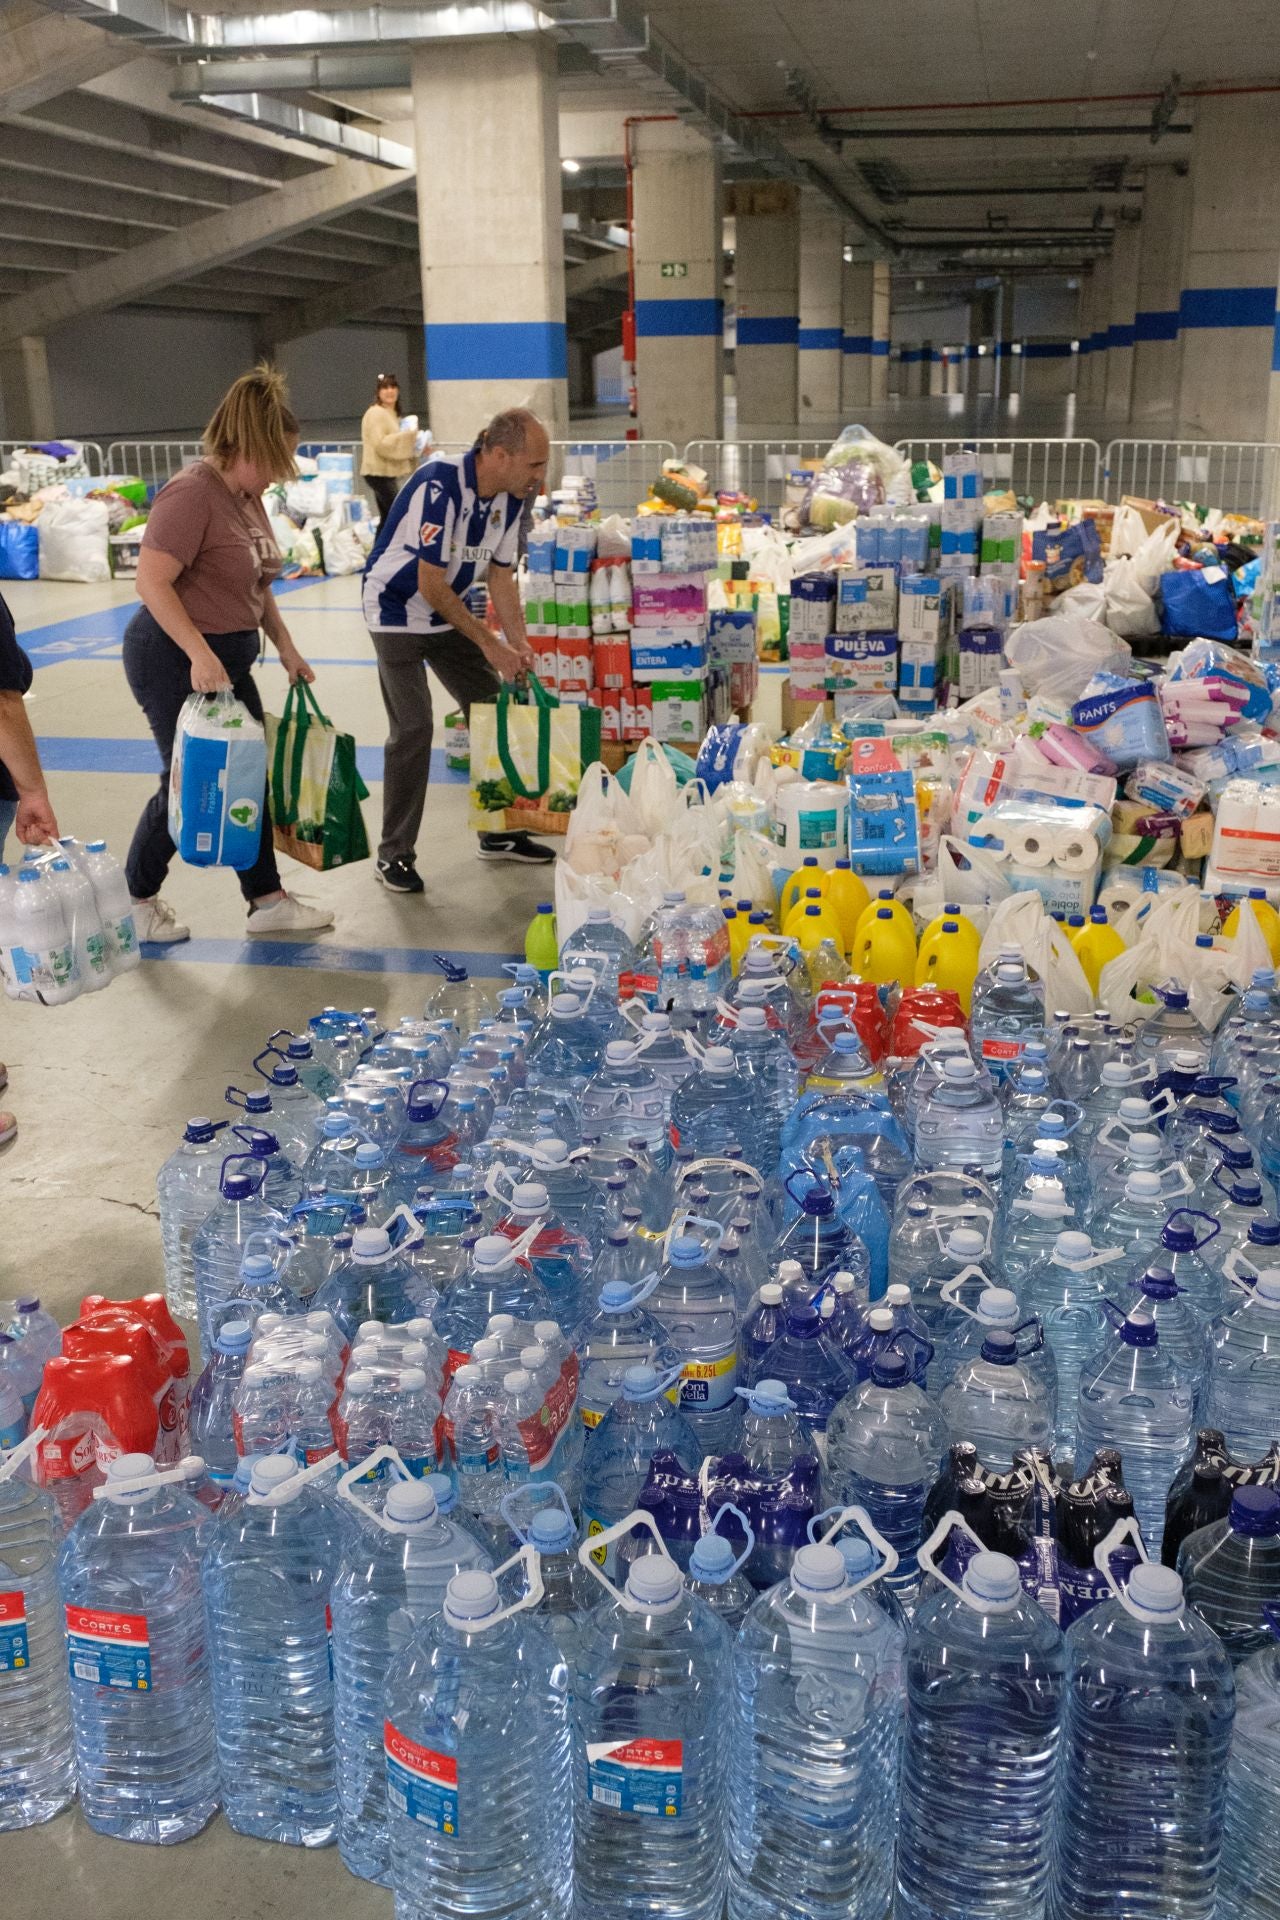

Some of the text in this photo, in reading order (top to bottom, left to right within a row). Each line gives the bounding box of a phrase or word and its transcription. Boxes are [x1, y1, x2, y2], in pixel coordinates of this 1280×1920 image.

[834, 640, 886, 652] PULEVA
[635, 656, 668, 666] ENTERA
[884, 661, 893, 672] 3
[1080, 702, 1116, 721] PANTS
[231, 806, 252, 824] 4
[1052, 900, 1080, 910] doble
[696, 1364, 716, 1378] 6.25L
[681, 1391, 706, 1400] Vella
[615, 1748, 664, 1760] ORTES
